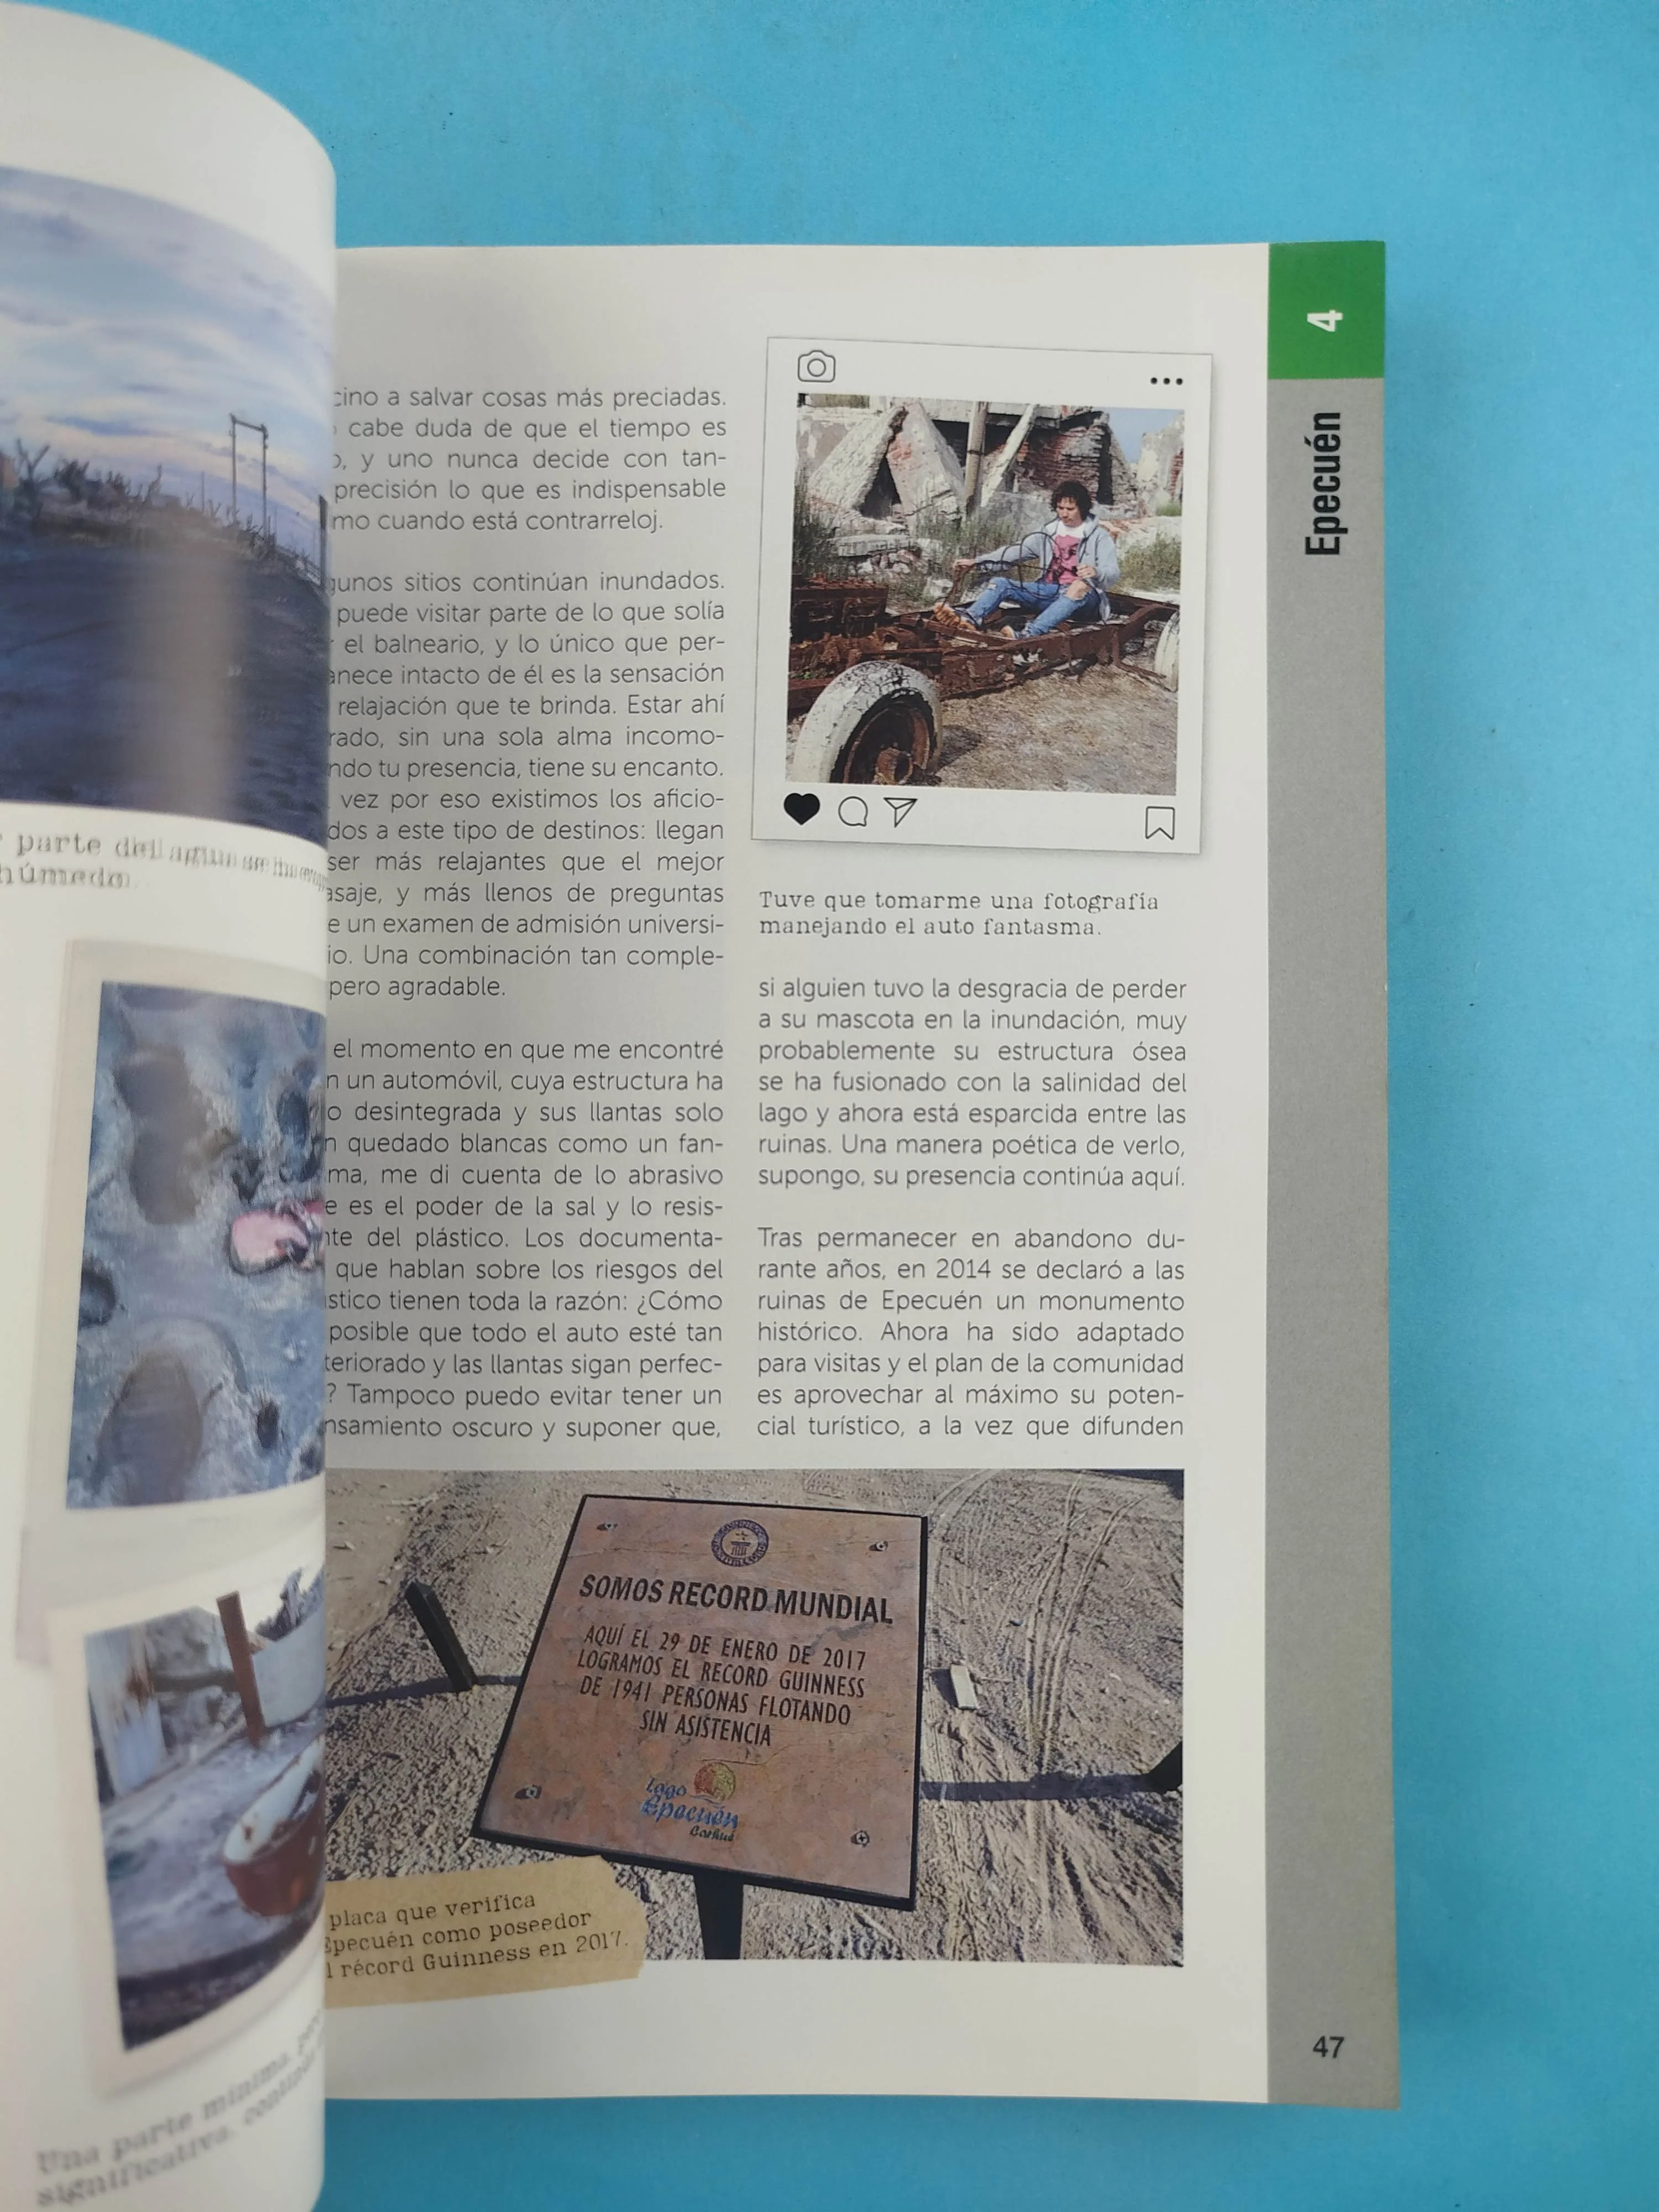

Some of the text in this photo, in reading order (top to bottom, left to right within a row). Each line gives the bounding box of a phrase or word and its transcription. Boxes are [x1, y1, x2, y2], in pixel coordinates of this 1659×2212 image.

[1307, 310, 1343, 332] 4
[334, 477, 726, 504] precisión lo que es indispensable
[1304, 413, 1348, 555] Epecuén
[337, 598, 724, 628] puede visitar parte de lo que solía
[338, 693, 726, 721] relajación que te brinda. Estar ahí
[326, 850, 725, 877] ser más relajantes que el mejor
[759, 890, 1159, 914] Tuve que tomarme una fotografía
[759, 916, 1101, 938] manejando el auto fantasma.
[364, 944, 408, 965] Una
[418, 944, 571, 965] combinación
[580, 946, 616, 966] tan
[627, 945, 724, 971] comple-
[327, 975, 505, 1001] pero agradable.
[333, 1037, 724, 1065] el momento en que me encontré
[759, 1039, 1186, 1065] probablemente su estructura ósea
[759, 1070, 1187, 1093] se ha fusionado con la salinidad del
[354, 1100, 500, 1127] desintegrada
[513, 1106, 527, 1127] y
[539, 1105, 577, 1122] sus
[590, 1101, 662, 1123] llantas
[675, 1102, 724, 1123] solo
[759, 1133, 1185, 1160] ruinas. Una manera poética de verlo,
[758, 1165, 1185, 1191] supongo, su presencia continúa aquí.
[757, 1227, 1185, 1253] Tras permanecer en abandono du-
[336, 1258, 723, 1285] que hablan sobre los riesgos del
[758, 1258, 1185, 1281] rante años, en 2014 se declaró a las
[329, 1320, 722, 1348] posible que todo el auto esté tan
[758, 1321, 1185, 1347] histórico. Ahora ha sido adaptado
[757, 1415, 1183, 1441] cial turístico, a la vez que difunden
[579, 1574, 893, 1624] SOMOS RECORD MUNDIAL
[584, 1623, 866, 1671] AQUÍ EL 29 DE ENERO DE 2017
[577, 1648, 865, 1698] LOGRAMOS EL RECORD GUINNESS
[580, 1676, 851, 1725] DE 1941 PERSONAS FLOTANDO
[639, 1709, 770, 1746] SIN ASISTENCIA
[646, 1777, 687, 1799] Lago
[330, 1894, 535, 1931] placa que verifica
[422, 1927, 480, 1945] como
[489, 1912, 591, 1942] poseedor
[341, 1956, 414, 1977] récord
[423, 1946, 530, 1970] Guinness
[540, 1942, 567, 1957] en
[577, 1931, 628, 1953] 2017.
[1313, 2035, 1344, 2058] 47
